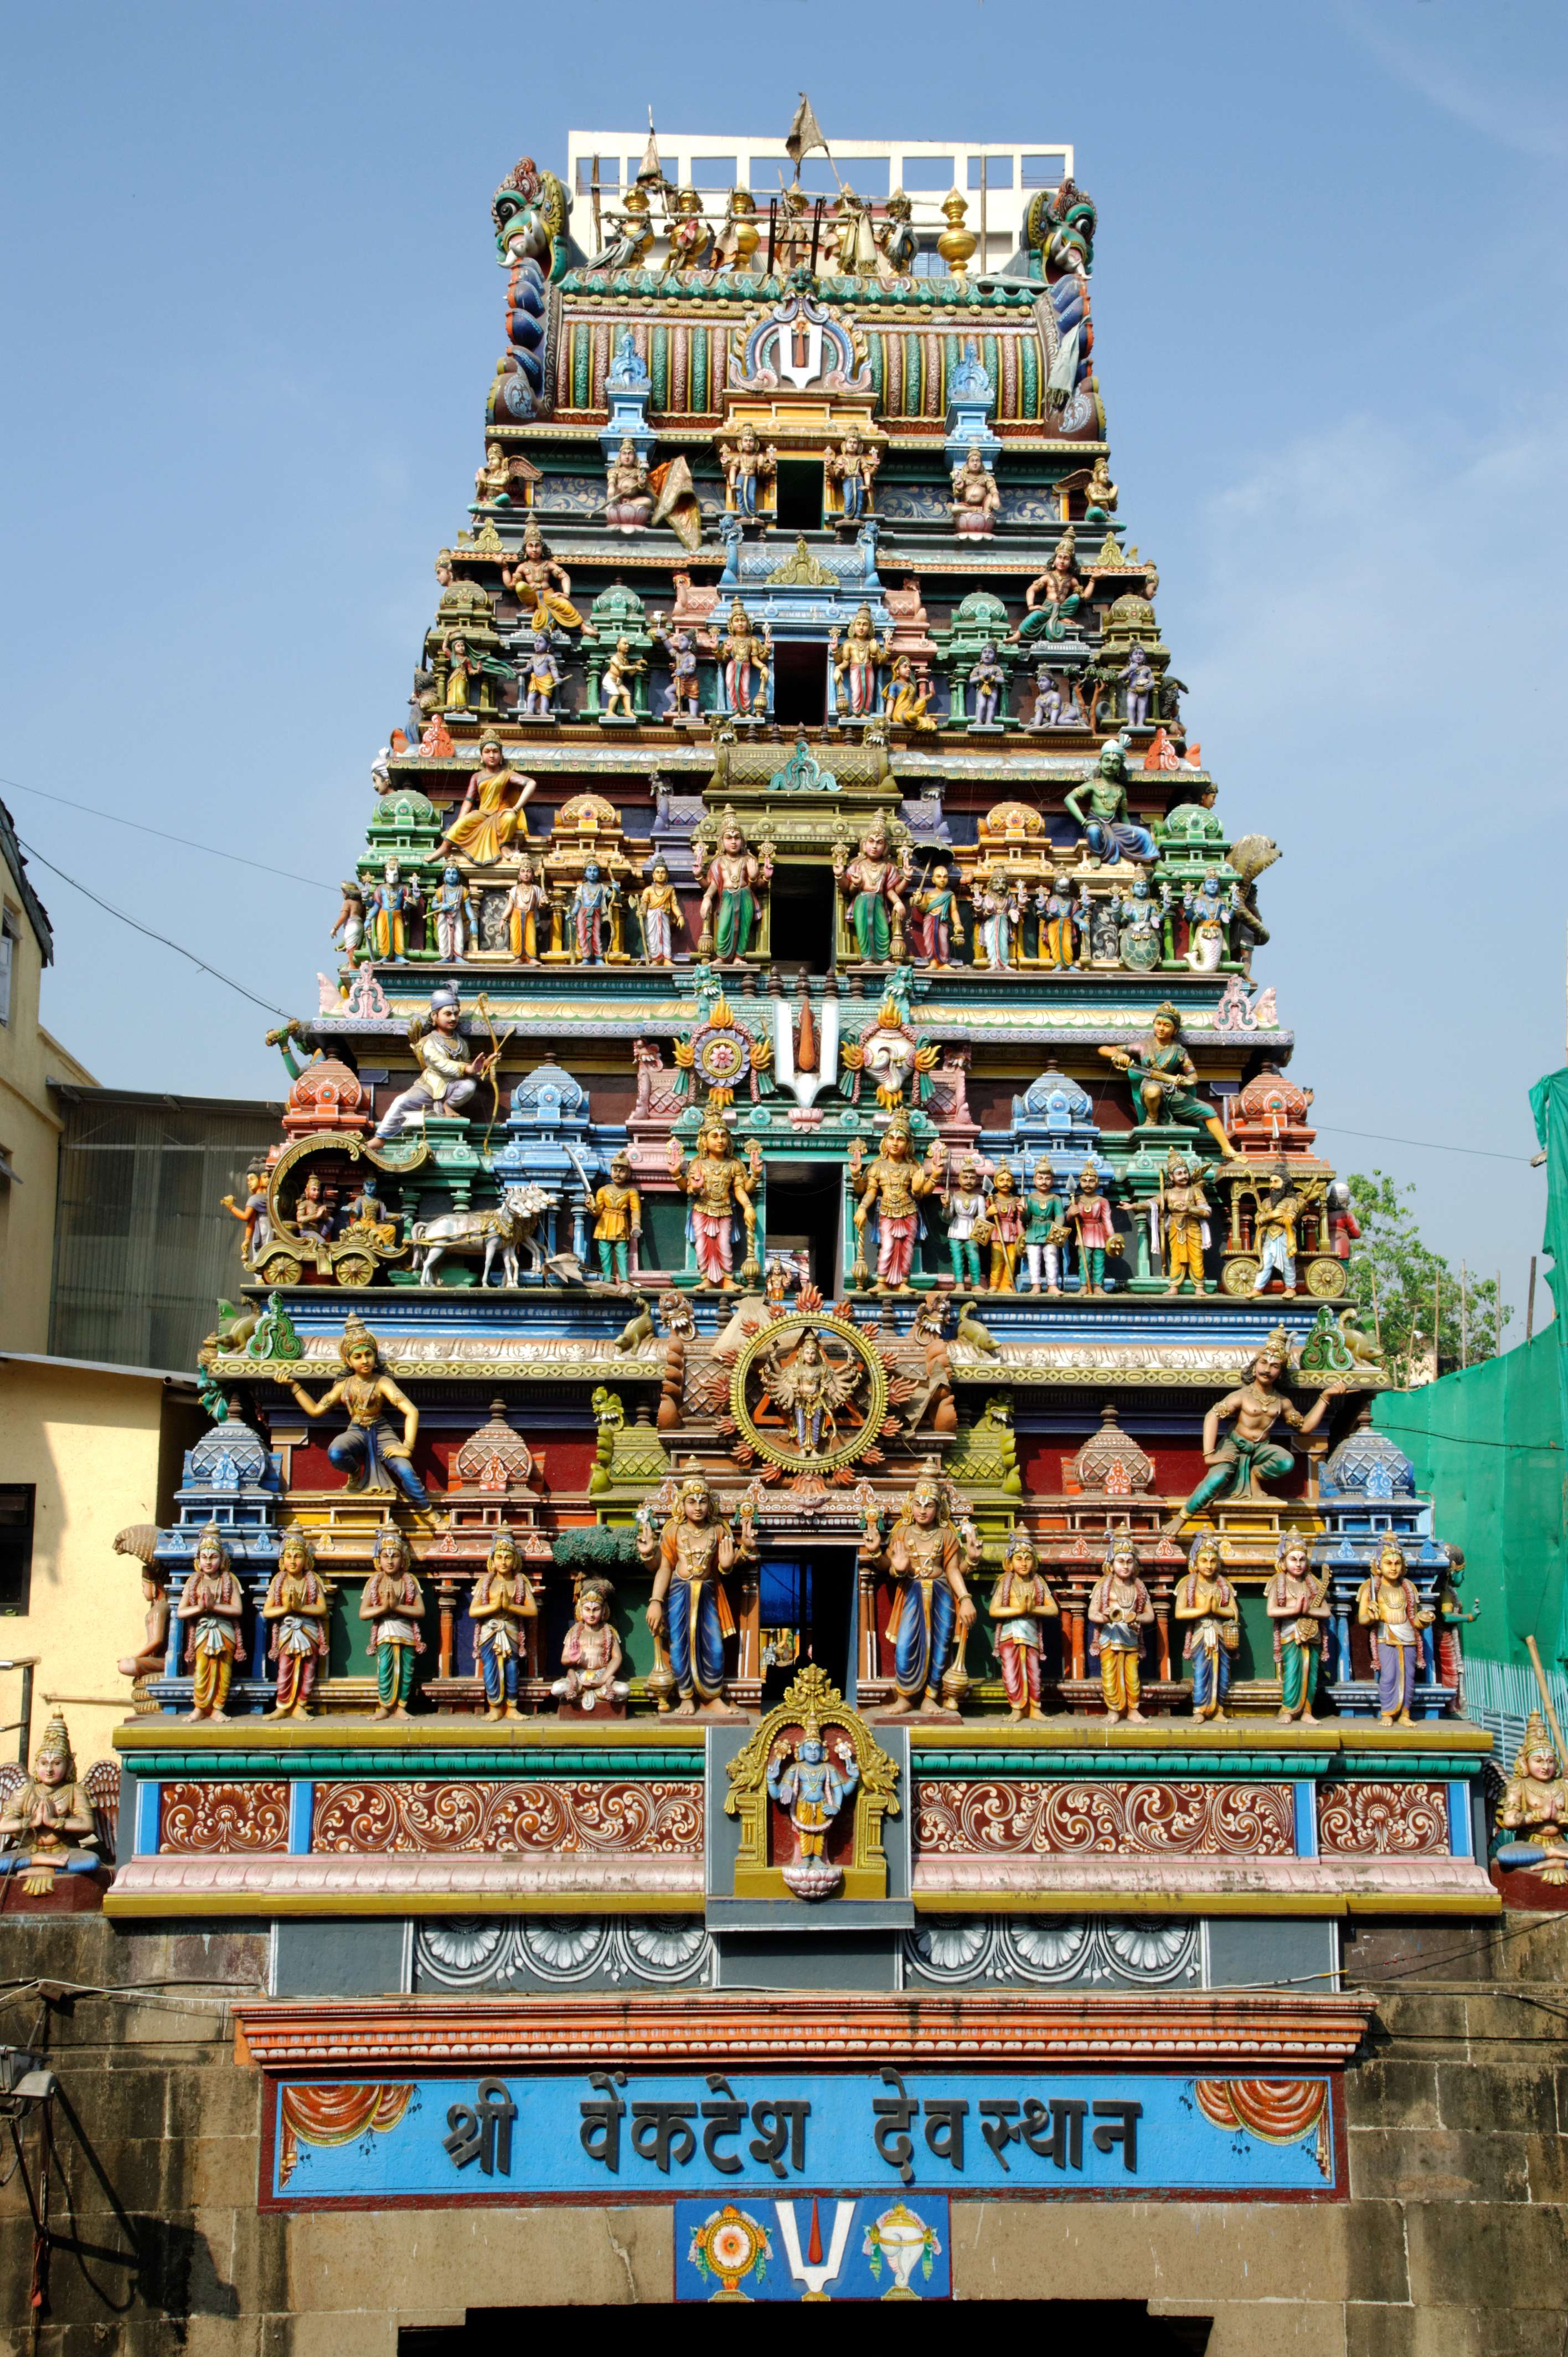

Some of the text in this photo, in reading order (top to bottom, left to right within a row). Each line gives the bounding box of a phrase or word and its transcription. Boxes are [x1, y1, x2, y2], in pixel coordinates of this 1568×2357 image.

[443, 2067, 1143, 2184] श्री वेंकटेश देवस्थान
